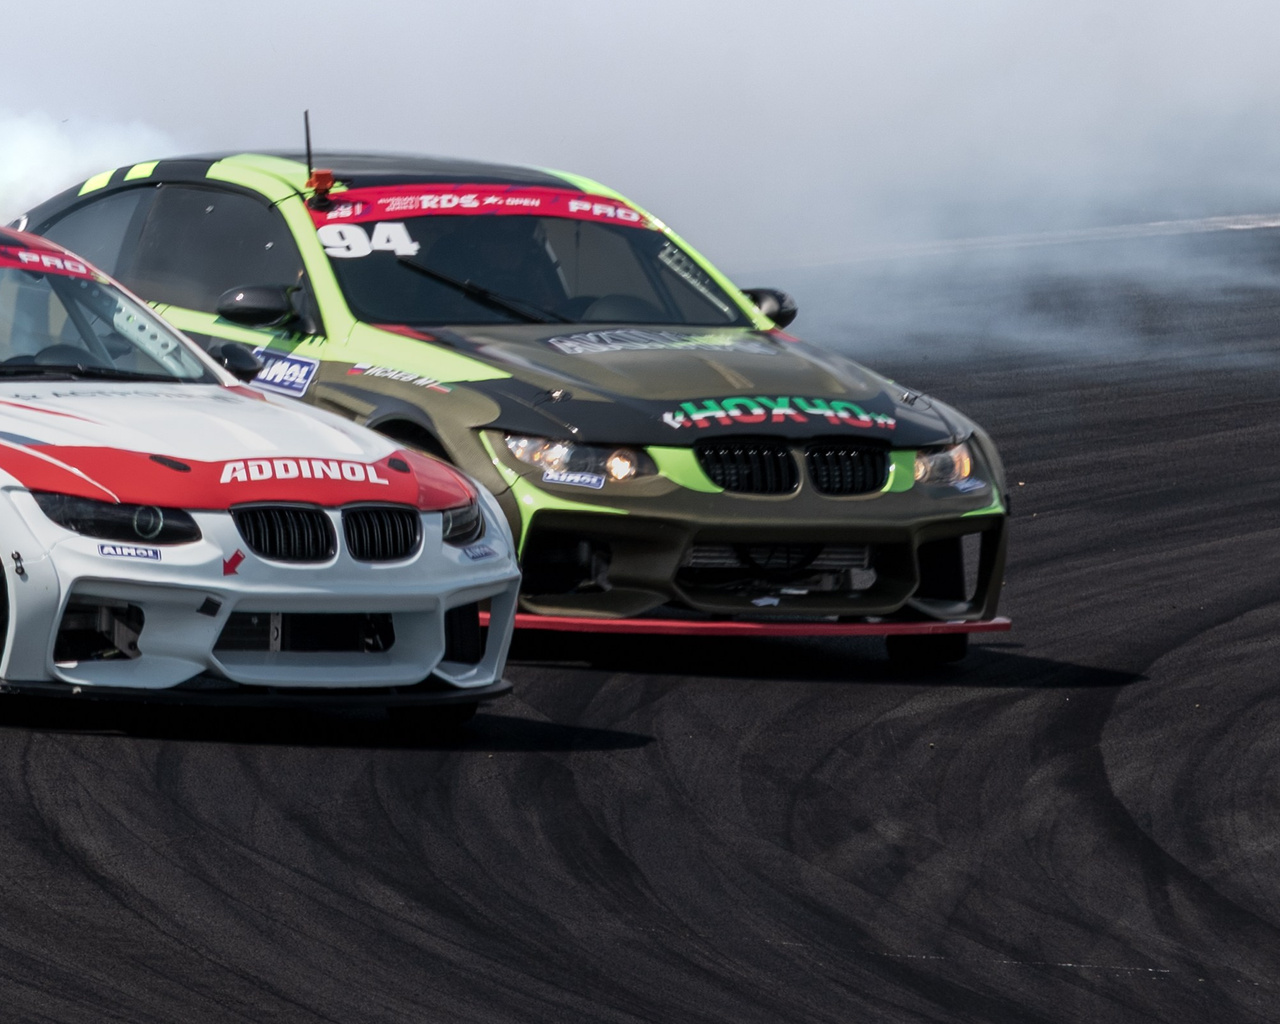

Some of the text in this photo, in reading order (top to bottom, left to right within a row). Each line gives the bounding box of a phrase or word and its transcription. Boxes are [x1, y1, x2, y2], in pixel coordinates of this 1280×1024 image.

[419, 194, 480, 210] RDS
[568, 198, 641, 223] PRO
[317, 221, 421, 259] 94
[19, 249, 87, 275] PRO
[257, 356, 308, 384] IMOL
[220, 458, 389, 486] ADDINOL
[102, 545, 157, 558] AIMOL
